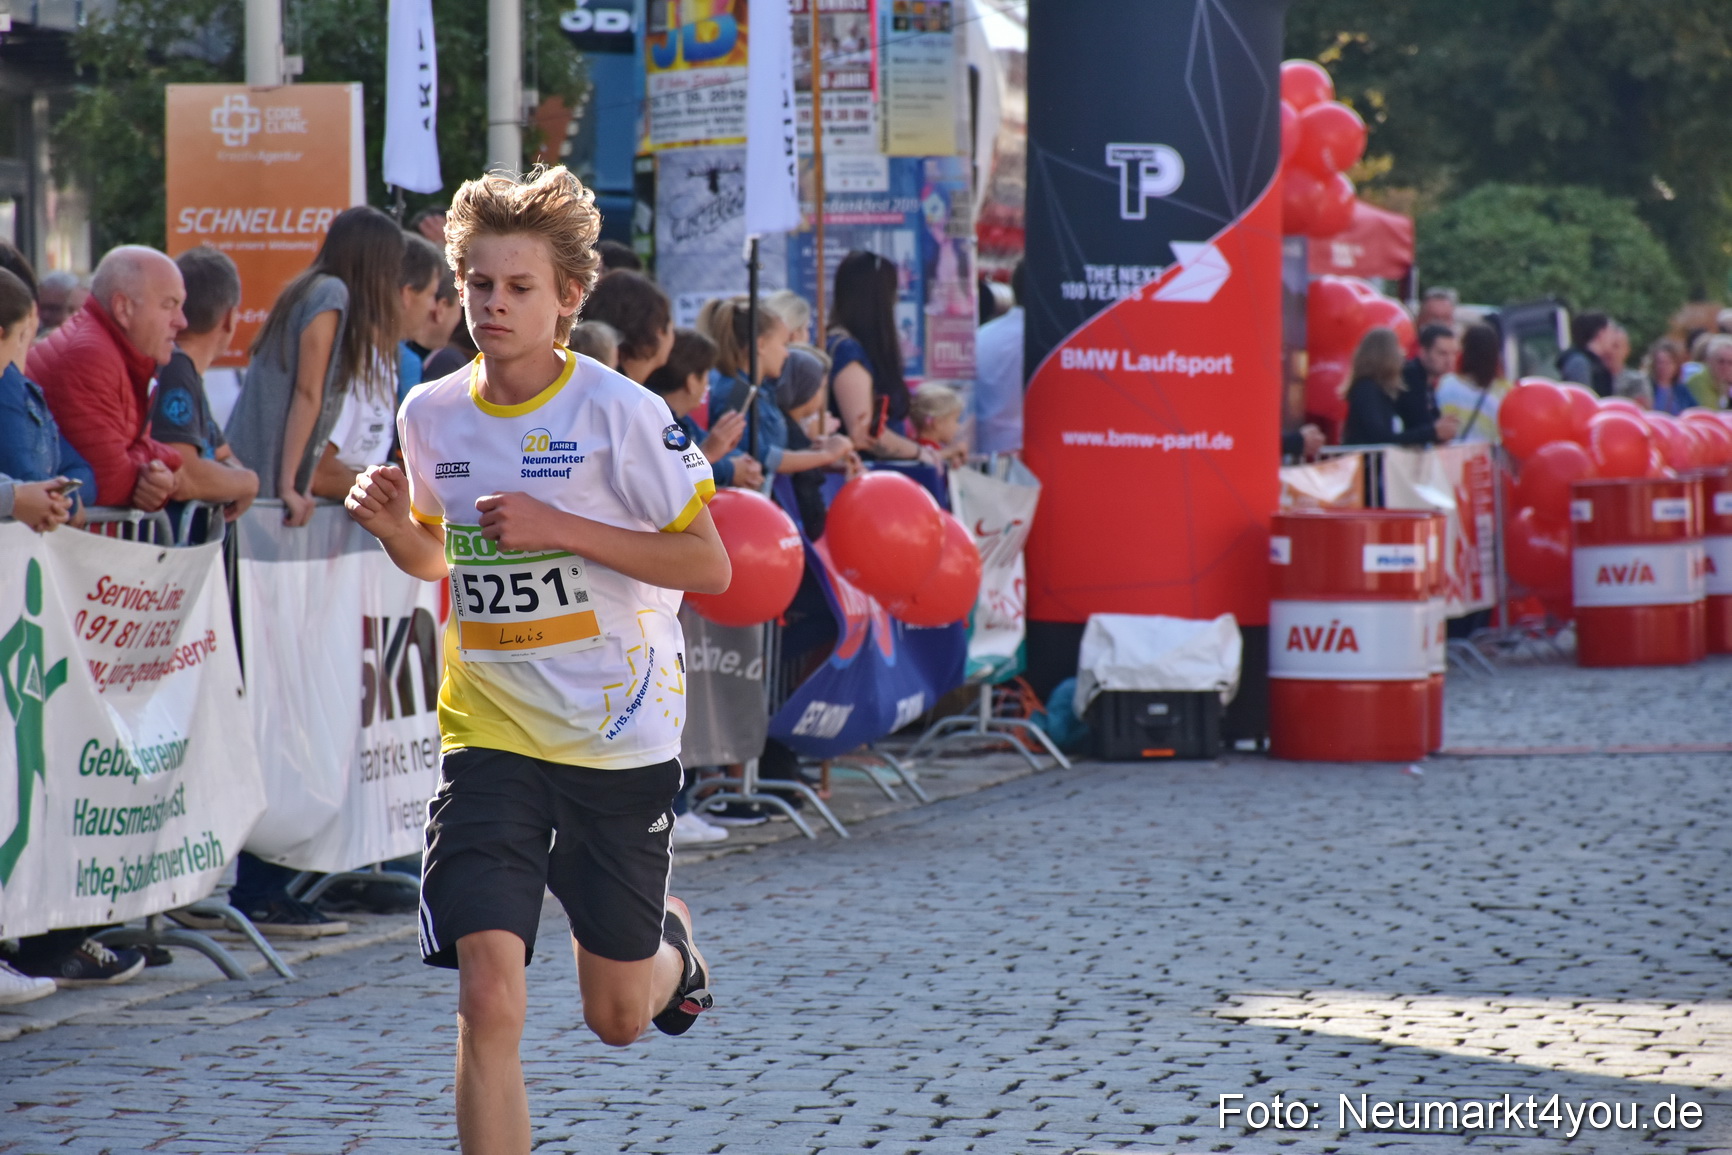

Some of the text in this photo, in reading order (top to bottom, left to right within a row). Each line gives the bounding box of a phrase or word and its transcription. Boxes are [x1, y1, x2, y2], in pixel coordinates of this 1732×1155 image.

[1084, 264, 1166, 284] THE NEXT
[1060, 281, 1143, 301] 100 YEARS
[1061, 348, 1233, 378] BMW Laufsport
[524, 435, 575, 452] 20 JAHRE
[436, 462, 470, 475] BOCK
[522, 454, 585, 465] Neumarkter
[521, 467, 572, 479] Stadtlauf
[571, 568, 579, 576] S
[462, 567, 569, 614] 5251
[499, 628, 544, 645] Luis
[1287, 619, 1359, 653] AVIA
[606, 715, 630, 740] 14./15.
[626, 667, 652, 715] September
